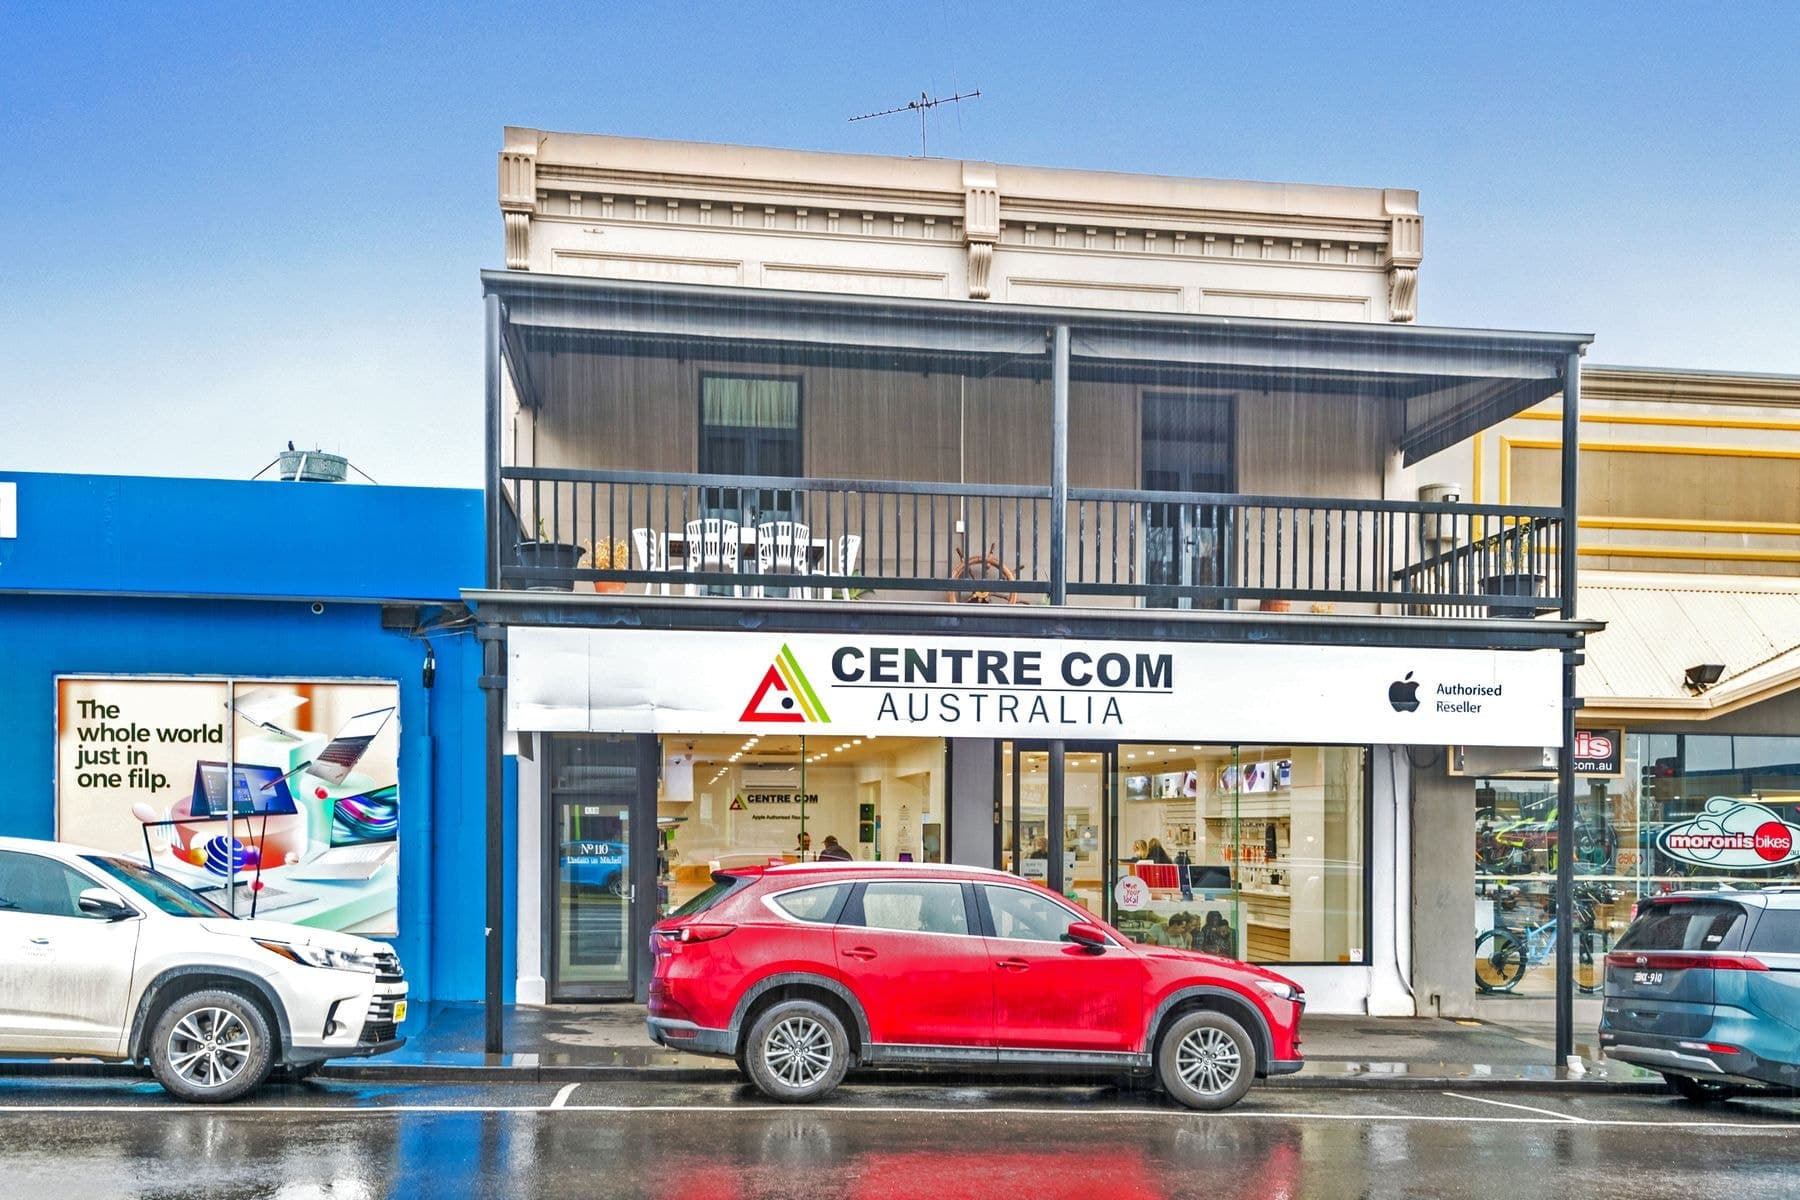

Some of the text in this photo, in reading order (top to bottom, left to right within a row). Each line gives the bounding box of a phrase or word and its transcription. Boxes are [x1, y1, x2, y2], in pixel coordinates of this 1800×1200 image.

[831, 646, 1173, 689] CENTRE COM
[1436, 683, 1502, 696] Authorised
[77, 699, 120, 719] The
[877, 692, 1123, 725] AUSTRALIA
[1436, 700, 1482, 713] Reseller
[77, 722, 223, 743] whole world
[75, 744, 148, 769] just in
[77, 768, 171, 793] one filp.
[747, 794, 791, 803] CENTRE
[1670, 832, 1790, 850] moronis bikes
